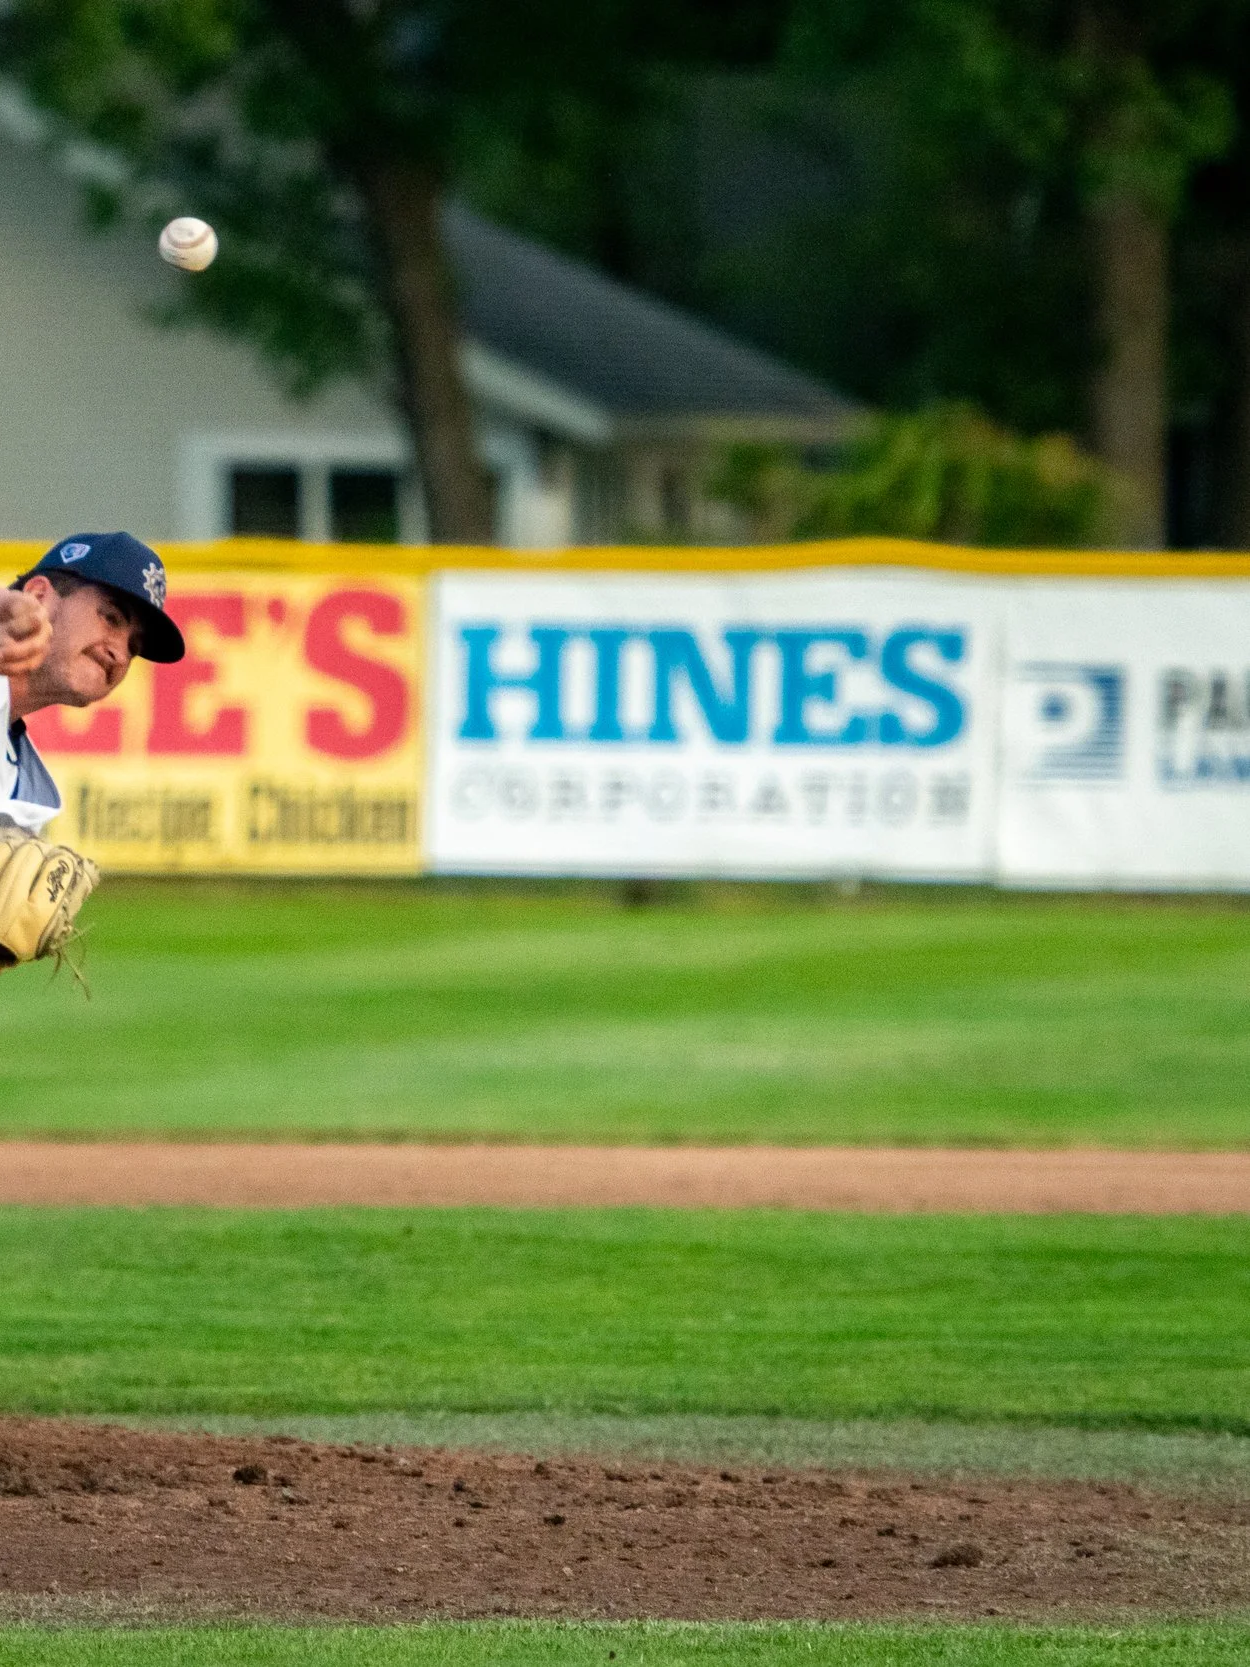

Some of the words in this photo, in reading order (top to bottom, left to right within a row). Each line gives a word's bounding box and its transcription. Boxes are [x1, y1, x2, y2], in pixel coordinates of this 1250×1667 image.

[457, 625, 968, 746] HINES
[1158, 670, 1250, 732] PA
[454, 770, 972, 826] CORPORATION
